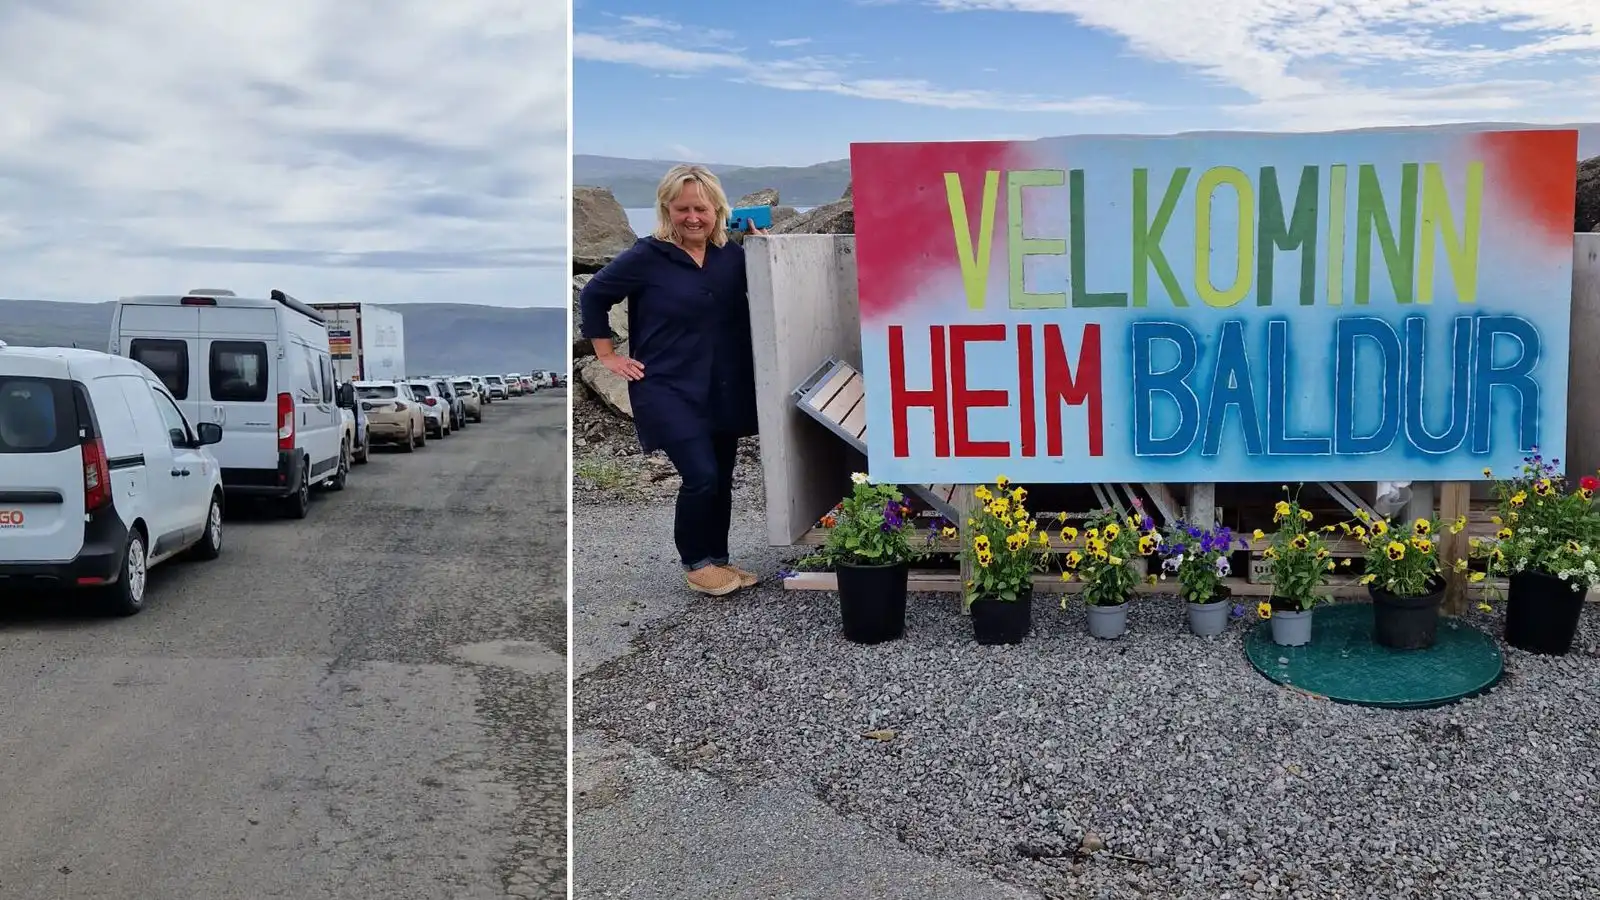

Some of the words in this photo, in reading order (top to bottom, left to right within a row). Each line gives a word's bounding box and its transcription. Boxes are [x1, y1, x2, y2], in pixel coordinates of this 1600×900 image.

[943, 162, 1484, 310] VELKOMINN
[888, 324, 1103, 457] HEIM
[1132, 316, 1541, 456] BALDUR
